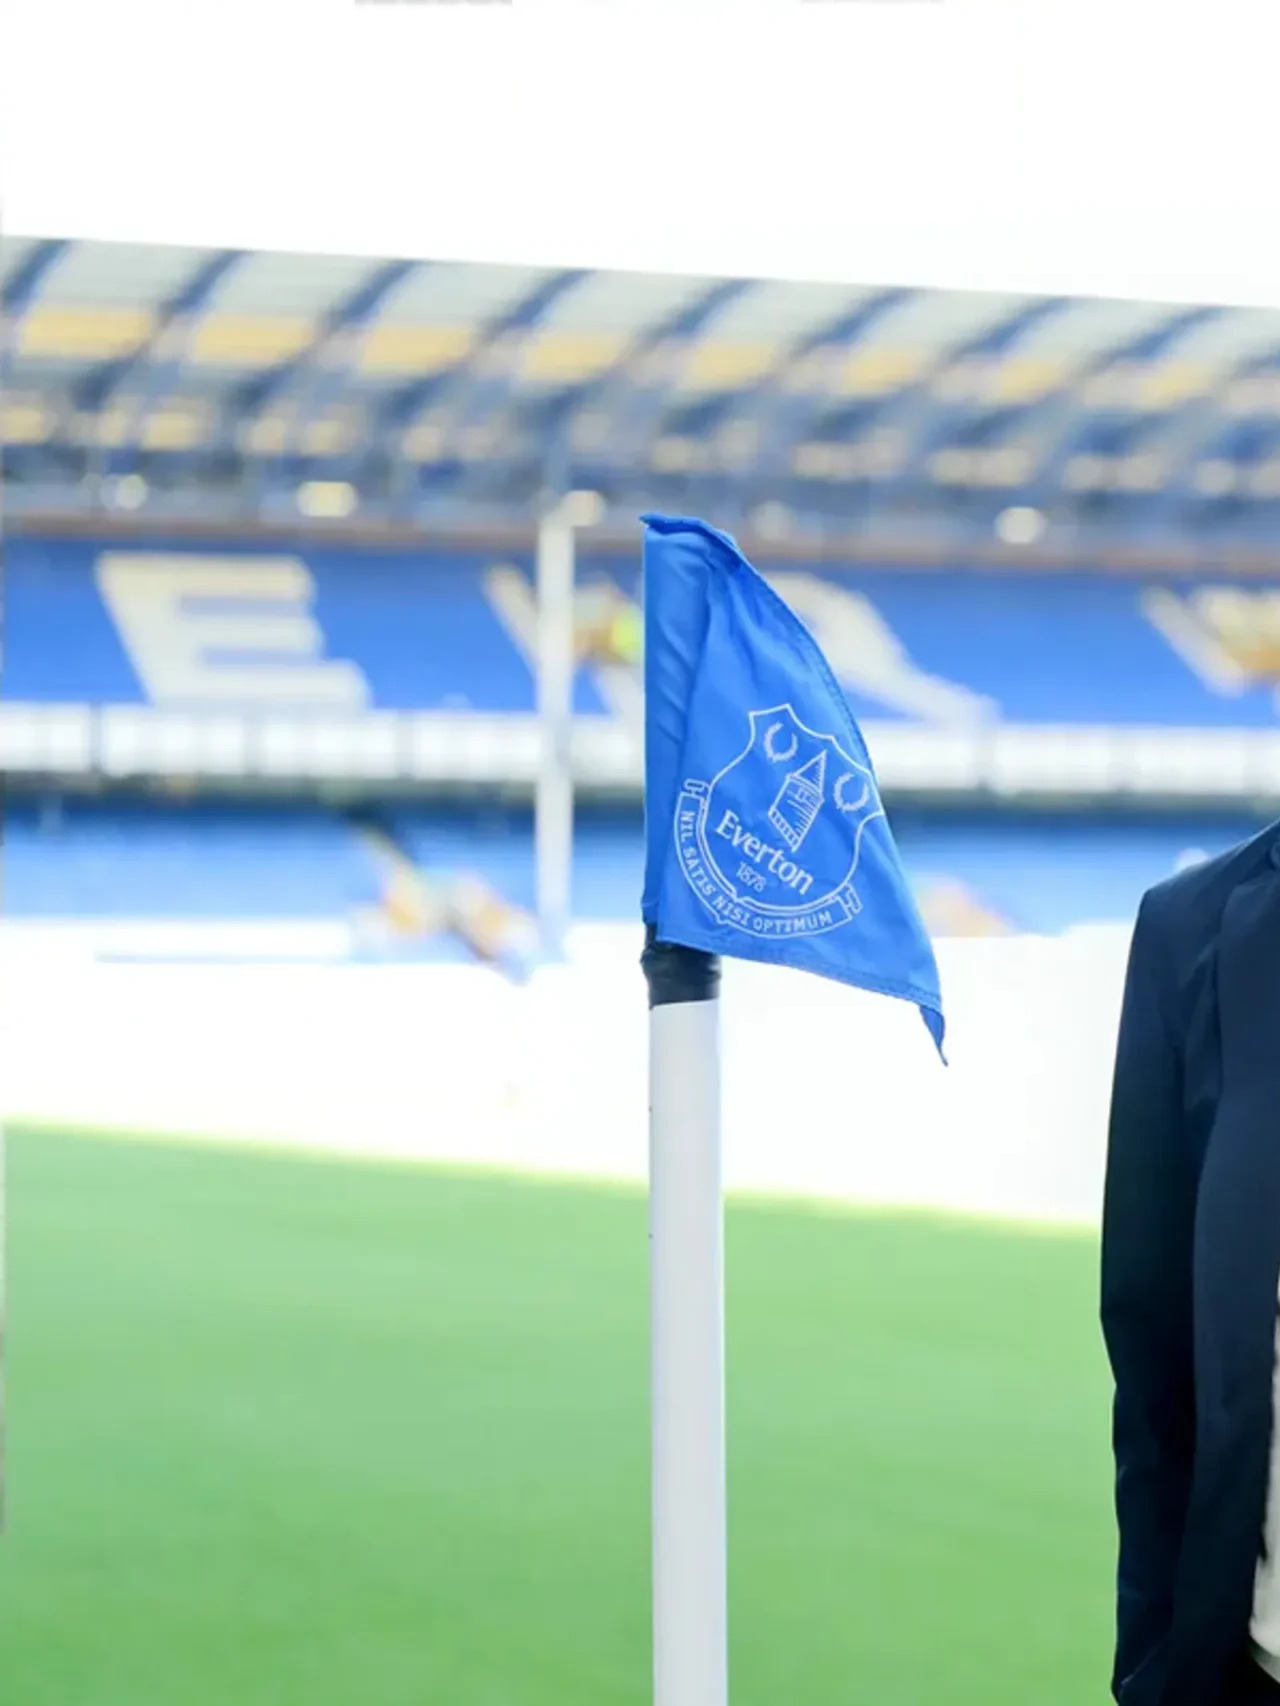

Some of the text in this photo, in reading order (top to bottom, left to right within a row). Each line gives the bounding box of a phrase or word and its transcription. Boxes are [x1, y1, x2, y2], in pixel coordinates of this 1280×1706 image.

[680, 810, 833, 934] NIL SATIS NISI OPTIMUM
[715, 809, 814, 895] Everton
[736, 861, 767, 893] 1878
